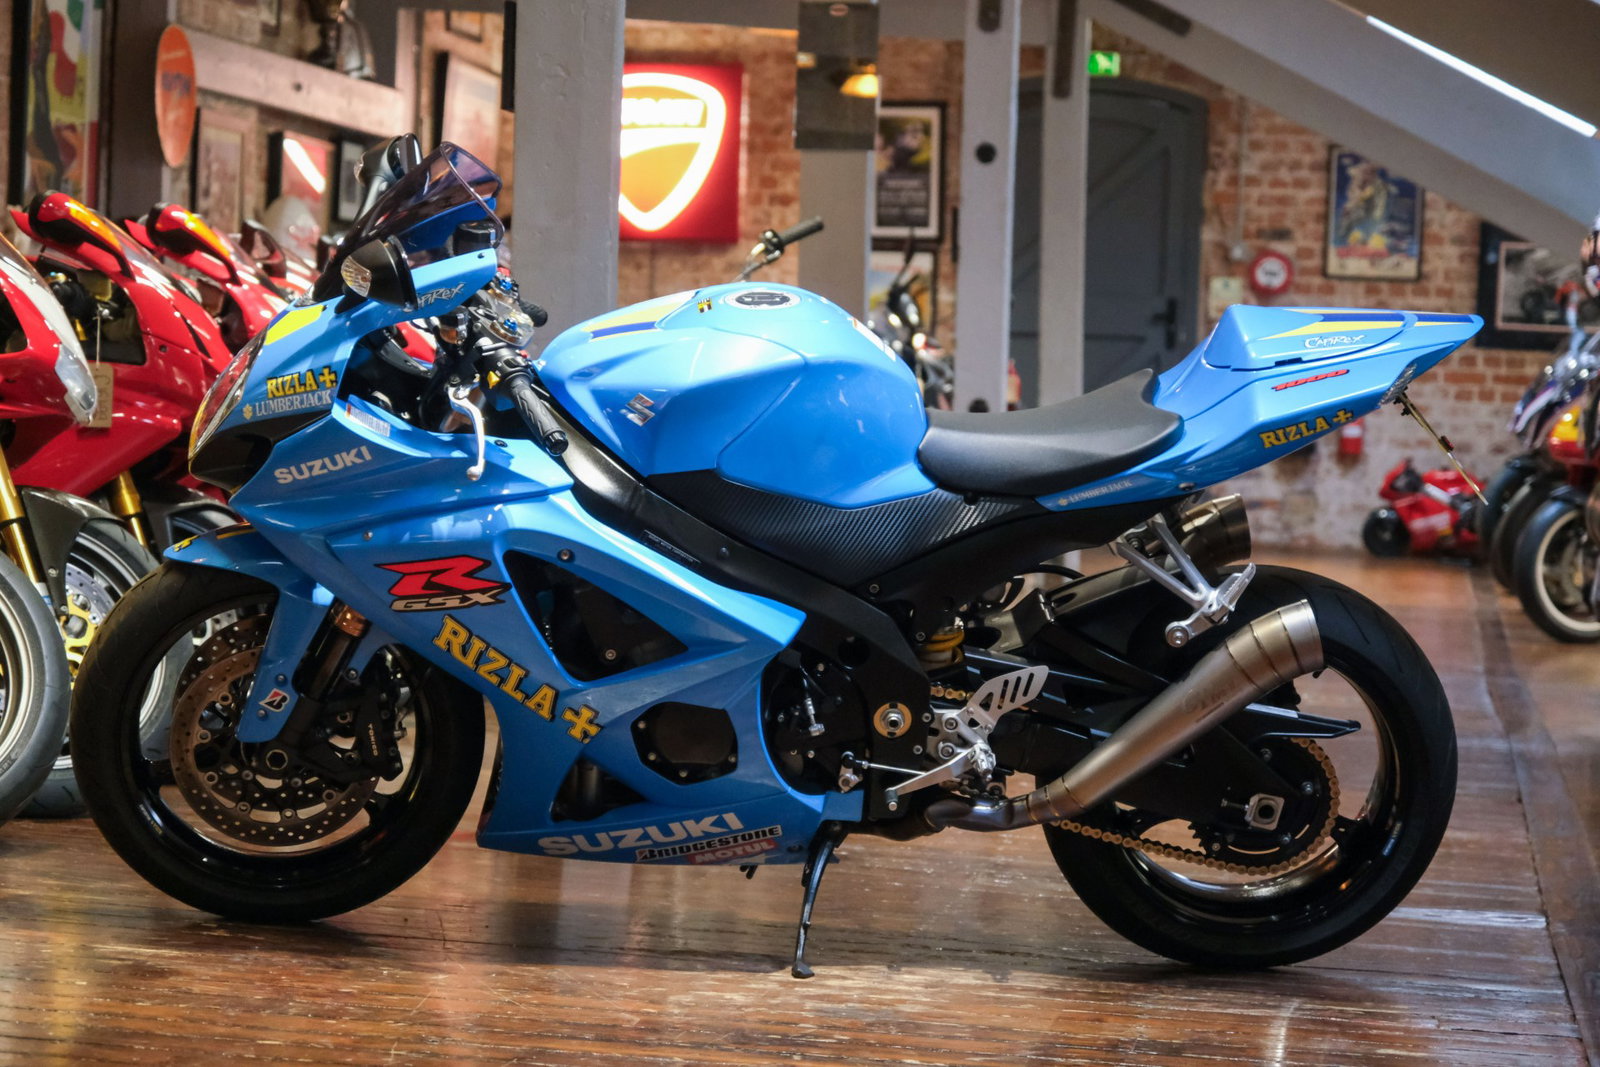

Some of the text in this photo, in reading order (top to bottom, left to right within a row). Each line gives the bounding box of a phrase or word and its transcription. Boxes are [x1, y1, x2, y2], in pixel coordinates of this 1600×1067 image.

[1271, 369, 1350, 392] 1000
[256, 389, 332, 417] LUMBERJACK
[273, 445, 373, 484] SUZUKI
[1069, 480, 1133, 503] LUMBERJACK
[390, 588, 506, 612] GSX
[537, 812, 745, 856] SUZUKI
[636, 825, 781, 862] BRIDGESTONE
[693, 840, 775, 864] MOTUL
